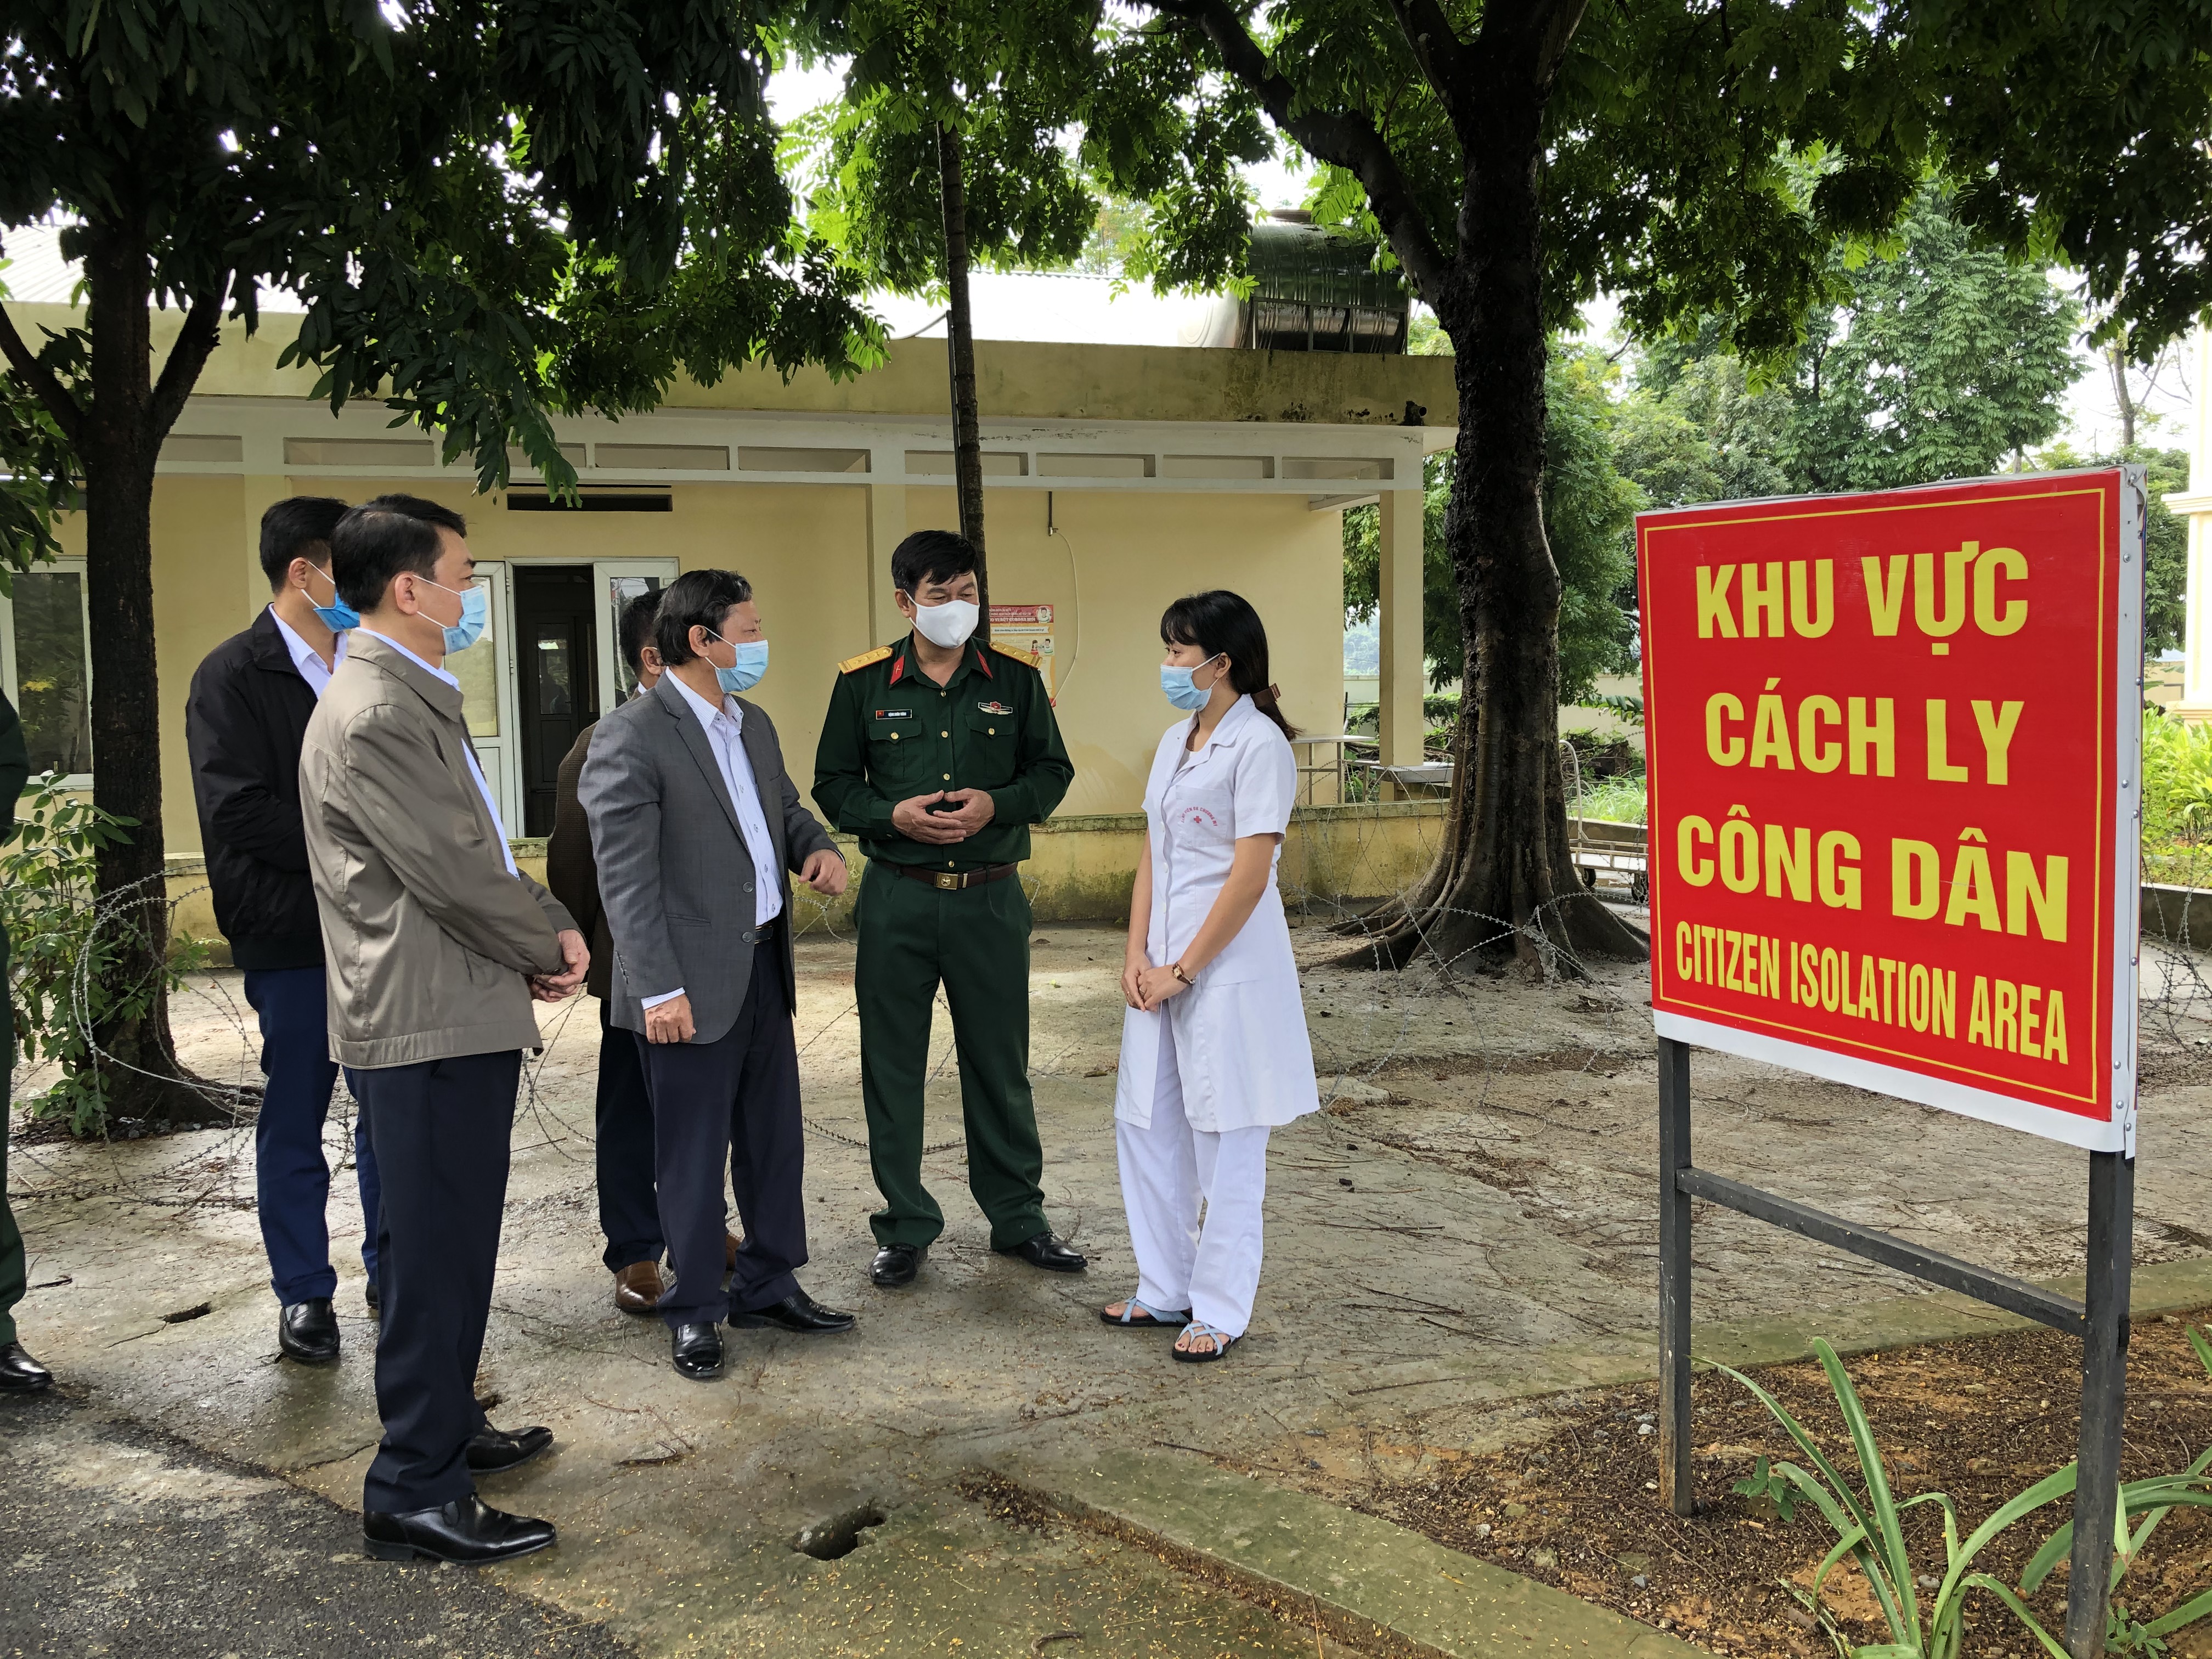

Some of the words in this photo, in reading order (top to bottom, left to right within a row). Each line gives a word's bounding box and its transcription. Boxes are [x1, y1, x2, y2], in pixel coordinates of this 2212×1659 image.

[1695, 558, 1835, 639] KHU
[1860, 540, 2029, 656] VỰC
[1705, 677, 1895, 778] CÁCH
[1926, 698, 2025, 786] LY
[1677, 804, 1862, 911] CÔNG
[1891, 826, 2069, 943] DÂN
[1675, 920, 1781, 1000] CITIZEN
[1790, 941, 1957, 1040] ISOLATION
[1967, 974, 2069, 1065] AREA
